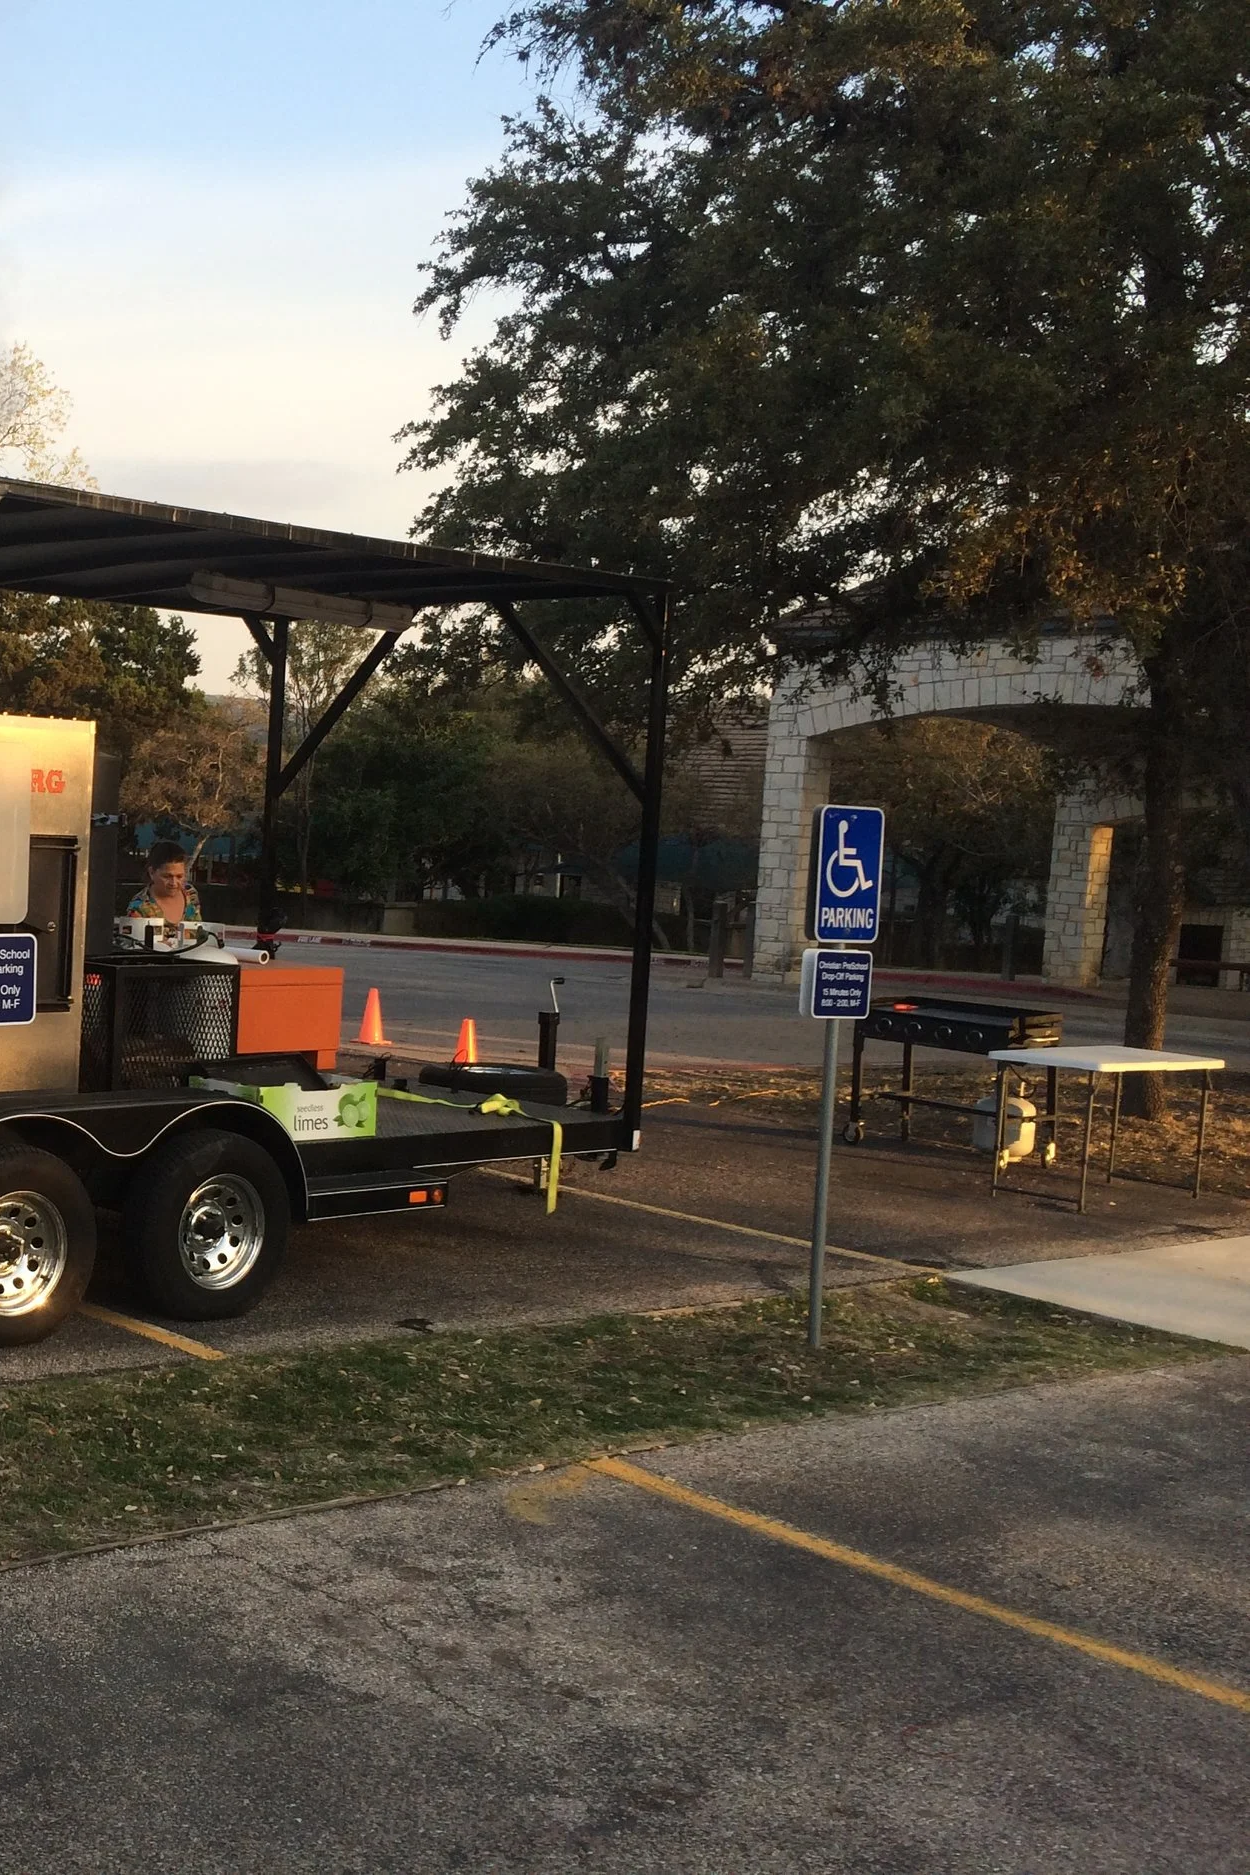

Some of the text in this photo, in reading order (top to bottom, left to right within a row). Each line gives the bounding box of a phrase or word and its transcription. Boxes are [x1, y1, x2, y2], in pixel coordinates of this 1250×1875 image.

[821, 907, 874, 929] PARKING
[845, 973, 865, 982] Parking
[0, 984, 21, 996] Only
[850, 989, 862, 998] Only
[2, 999, 20, 1009] M-F
[296, 1104, 324, 1113] seedless
[293, 1115, 329, 1131] limes
